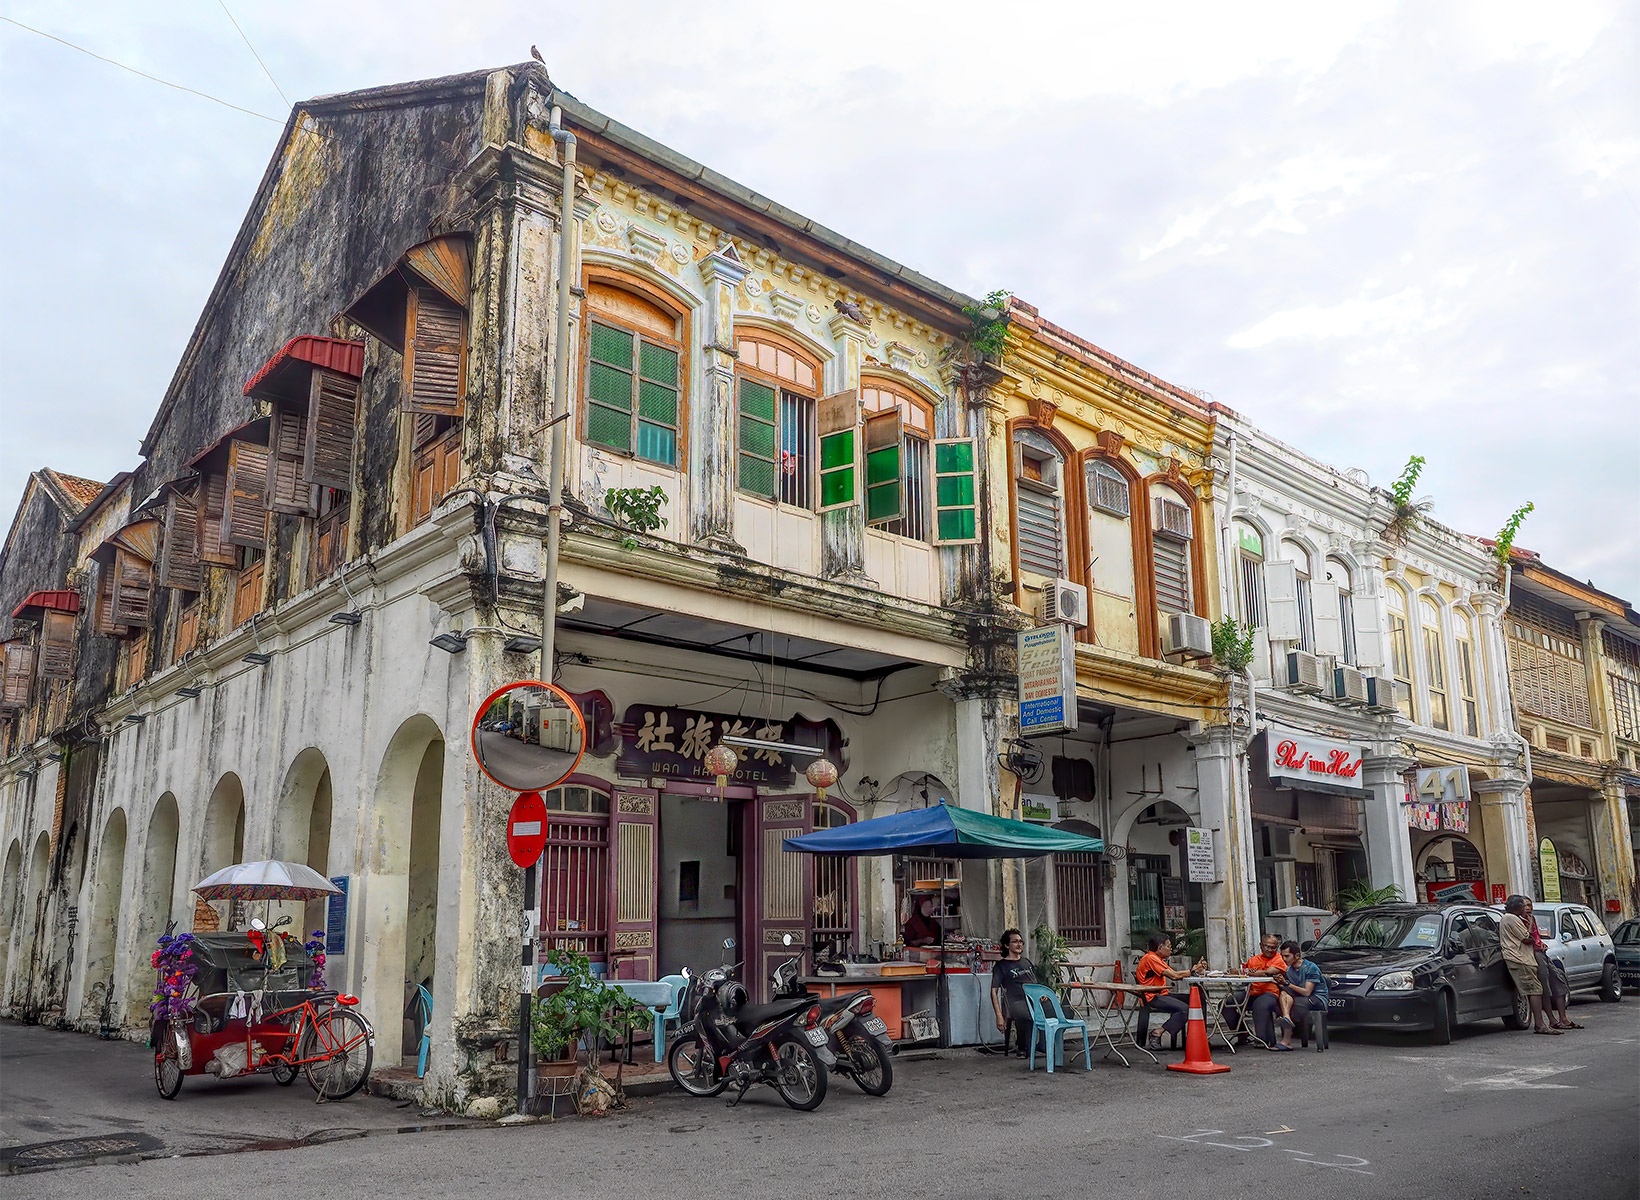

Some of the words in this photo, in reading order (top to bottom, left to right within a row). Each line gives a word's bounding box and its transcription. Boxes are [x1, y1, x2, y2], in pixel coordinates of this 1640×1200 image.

[1021, 656, 1060, 671] Tech
[1023, 710, 1034, 718] And
[1026, 717, 1038, 725] Call
[1275, 739, 1309, 769] Red
[1327, 749, 1363, 778] Hotel
[652, 762, 680, 774] WAN
[1420, 769, 1464, 800] 41
